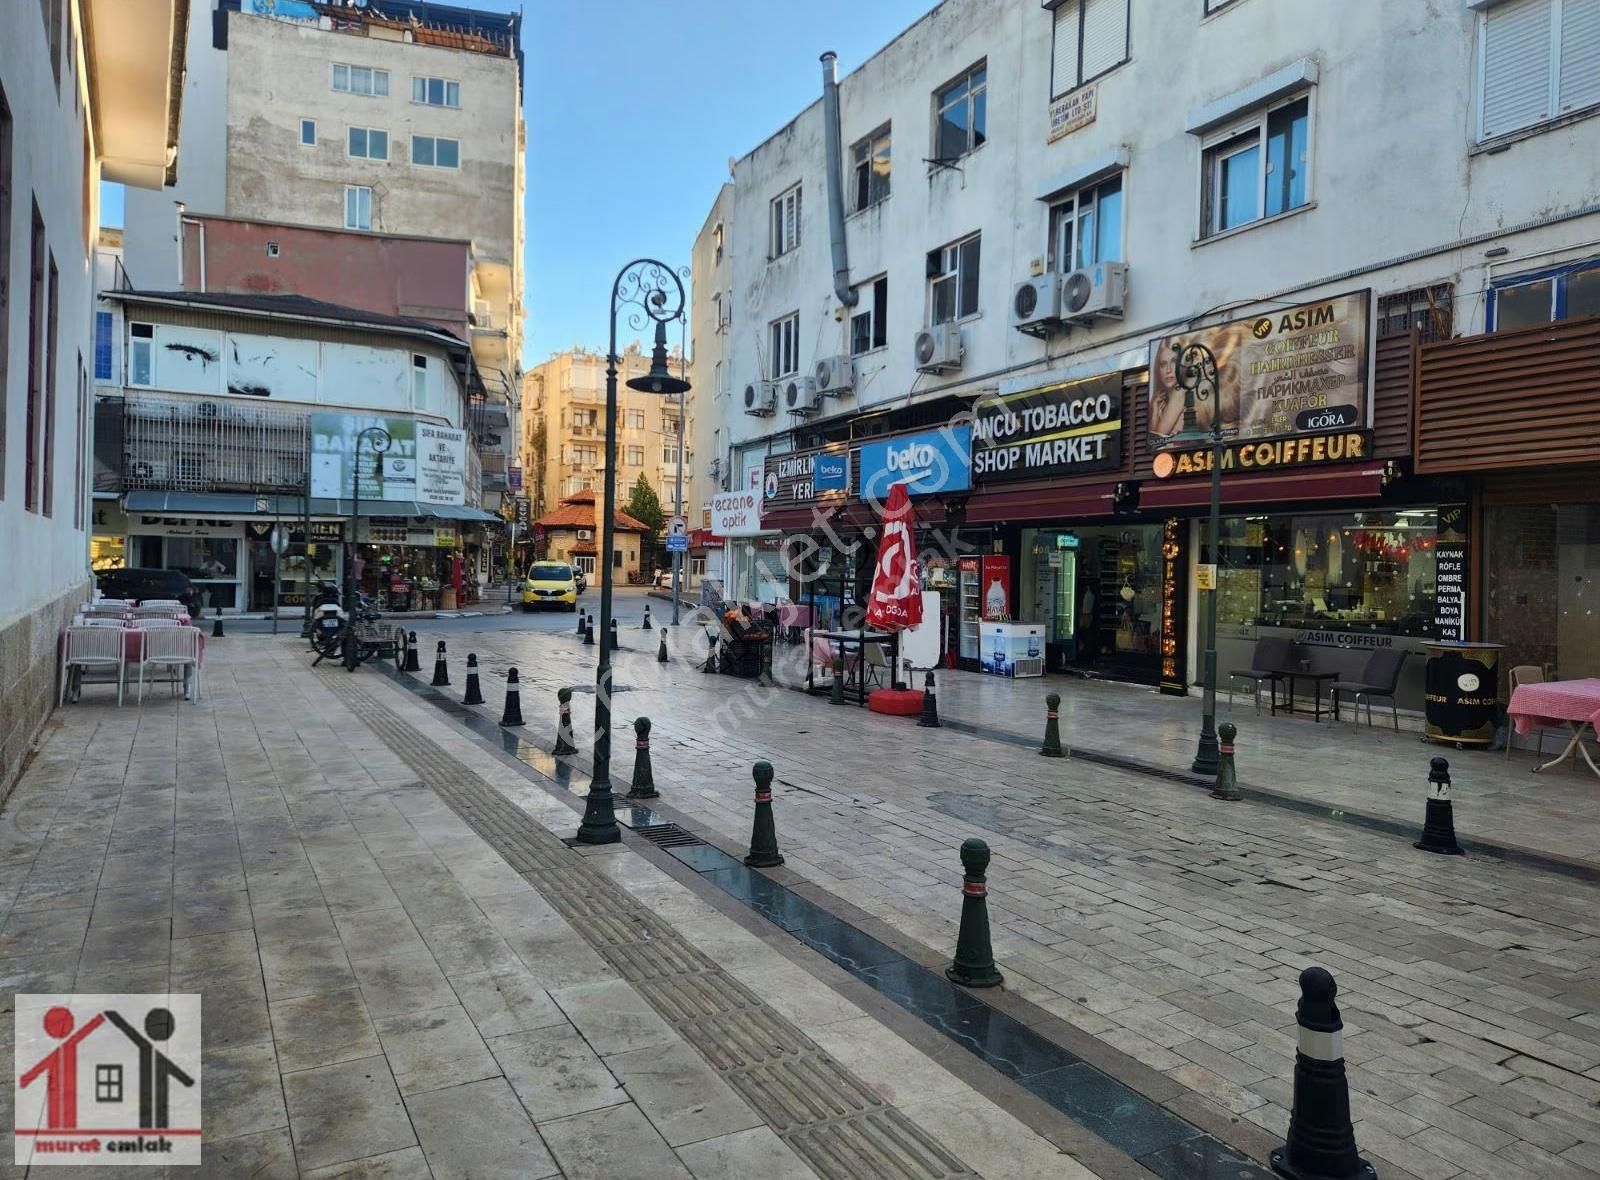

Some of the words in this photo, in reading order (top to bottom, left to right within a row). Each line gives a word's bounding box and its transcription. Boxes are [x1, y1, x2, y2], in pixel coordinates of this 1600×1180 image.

[1278, 304, 1335, 334] ASIM
[1254, 320, 1270, 337] VIP
[1264, 330, 1340, 355] COIFFEUR
[1251, 344, 1356, 376] HAIRDRESSER
[1257, 374, 1346, 400] ПАРИКМАХЕР
[1271, 391, 1328, 413] KUAFÖR
[972, 412, 1017, 441] ANCU
[1022, 393, 1111, 433] TOBACCO
[1308, 412, 1345, 428] IGORA
[314, 433, 416, 455] BAHAAT
[886, 442, 933, 472] beko
[974, 447, 1020, 473] SHOP
[1025, 433, 1107, 468] MARKET
[1176, 448, 1234, 474] ASIM
[1239, 433, 1363, 467] COIFFEUR
[820, 465, 843, 474] beko
[792, 477, 814, 500] YERİ
[715, 495, 754, 512] eczane
[722, 511, 747, 531] optik
[1442, 508, 1461, 525] VIP
[1437, 551, 1463, 559] KAYNAK
[1438, 574, 1462, 583] OMBRE
[1438, 585, 1461, 593] PERMA
[1440, 607, 1459, 615] BOYA
[1435, 617, 1461, 625] MANİKÜ
[1307, 631, 1334, 643] ASIM
[1337, 633, 1393, 648] COIFFEUR
[1442, 628, 1457, 637] KAŞ
[1457, 697, 1480, 705] ASIM
